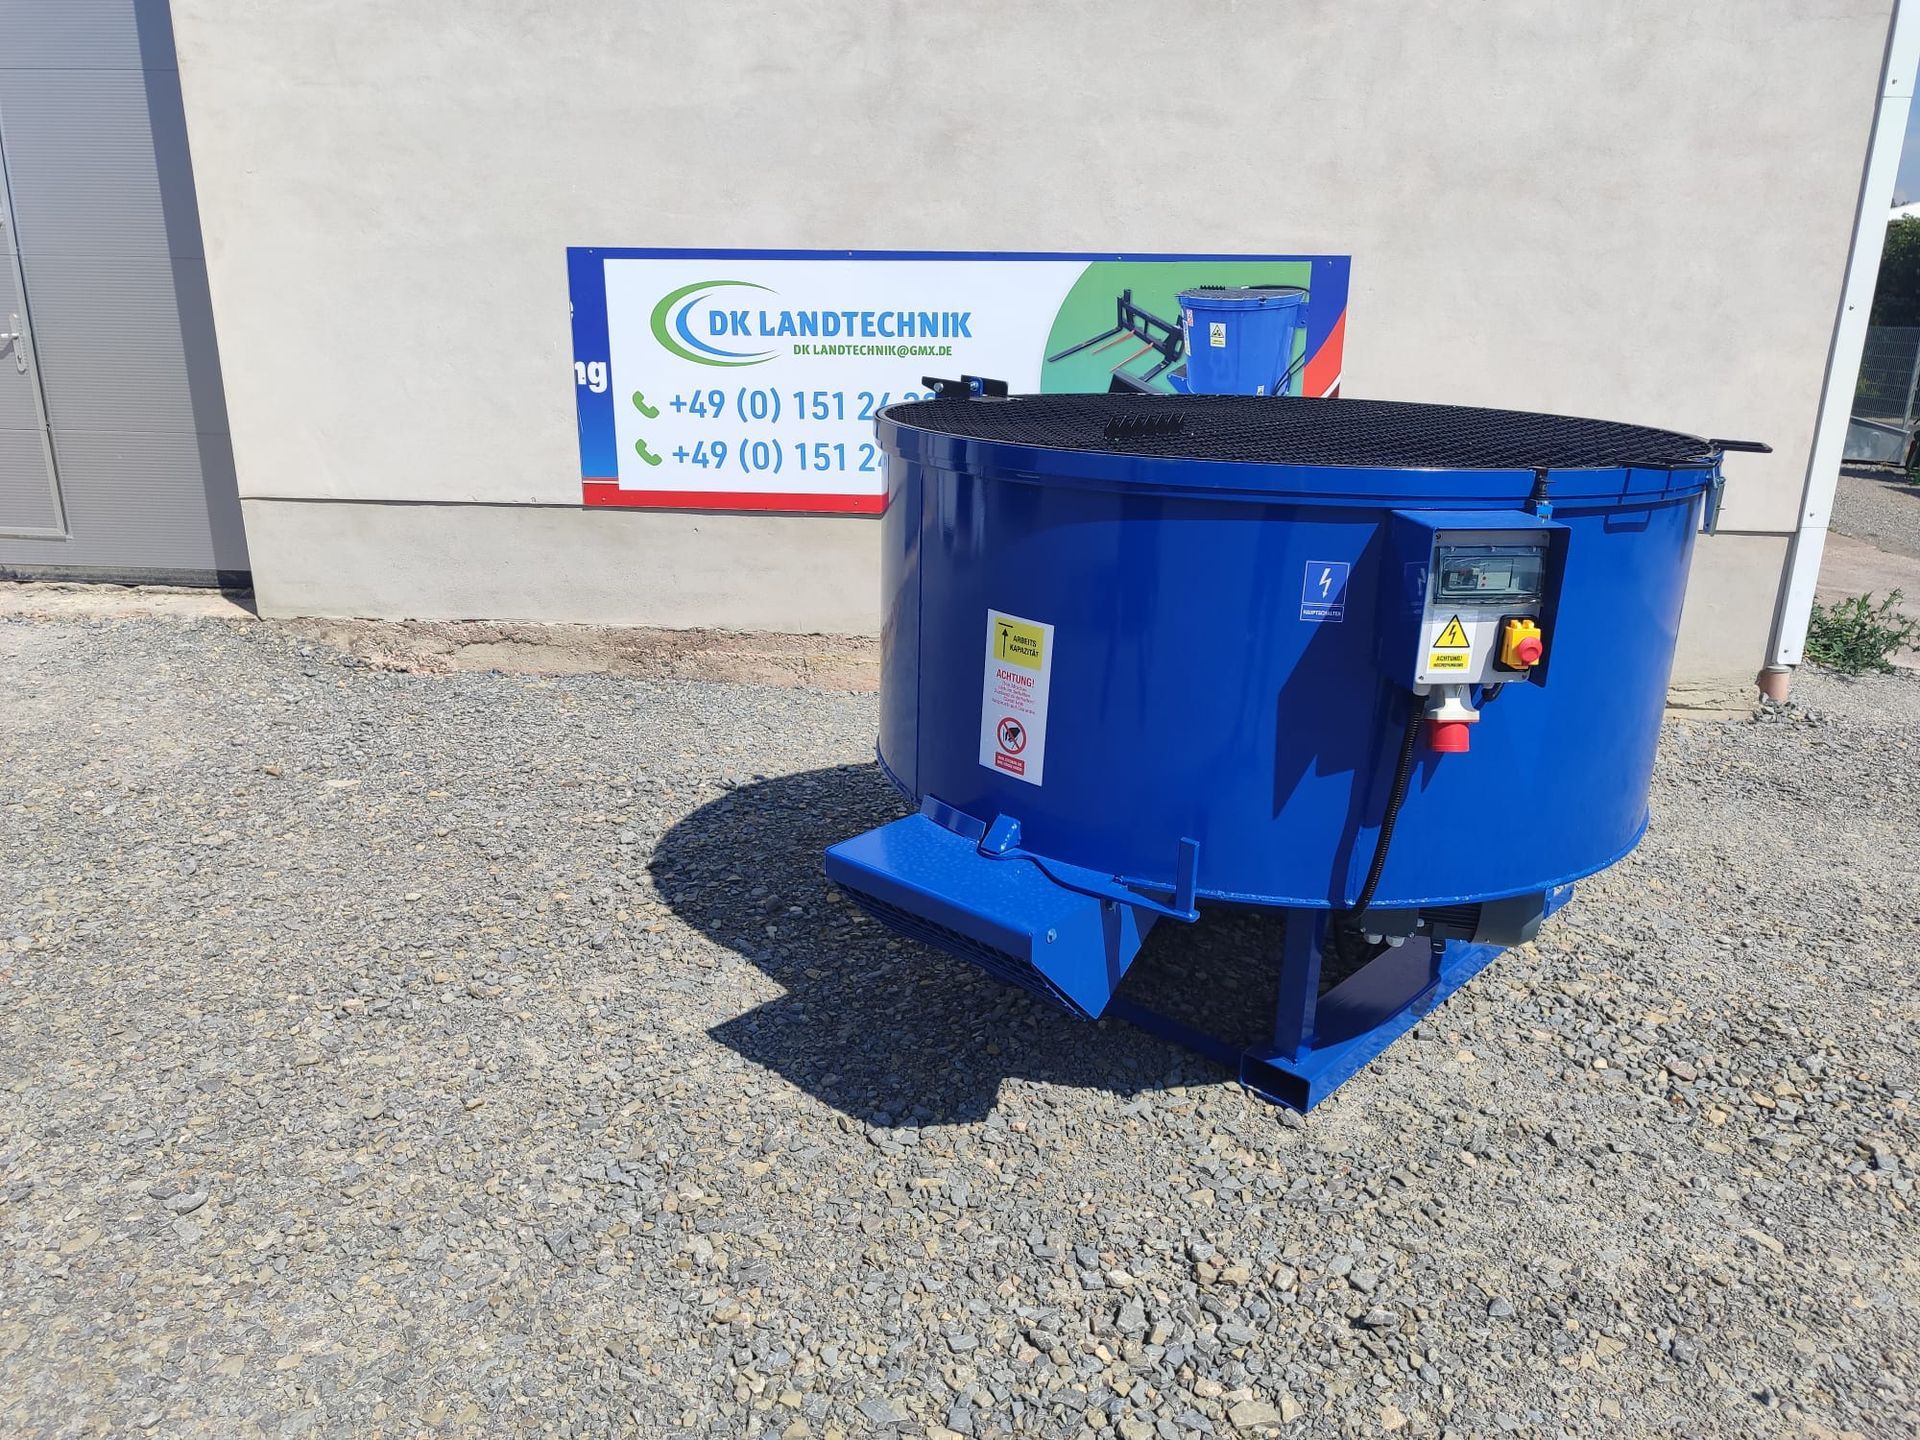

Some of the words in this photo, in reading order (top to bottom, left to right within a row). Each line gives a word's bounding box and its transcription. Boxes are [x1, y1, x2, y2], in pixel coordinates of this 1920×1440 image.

[709, 310, 752, 336] DK
[759, 310, 973, 338] LANDTECHNIK
[793, 344, 811, 355] DK
[813, 344, 953, 358] LANDTECHNIK@GMX.DE
[669, 390, 725, 418] +49
[737, 387, 780, 424] (0)
[793, 391, 844, 420] 151
[672, 441, 727, 469] +49
[739, 438, 782, 474] (0)
[795, 442, 845, 471] 151
[1013, 635, 1037, 648] ARBEITS
[996, 669, 1035, 688] ACHTUNG!
